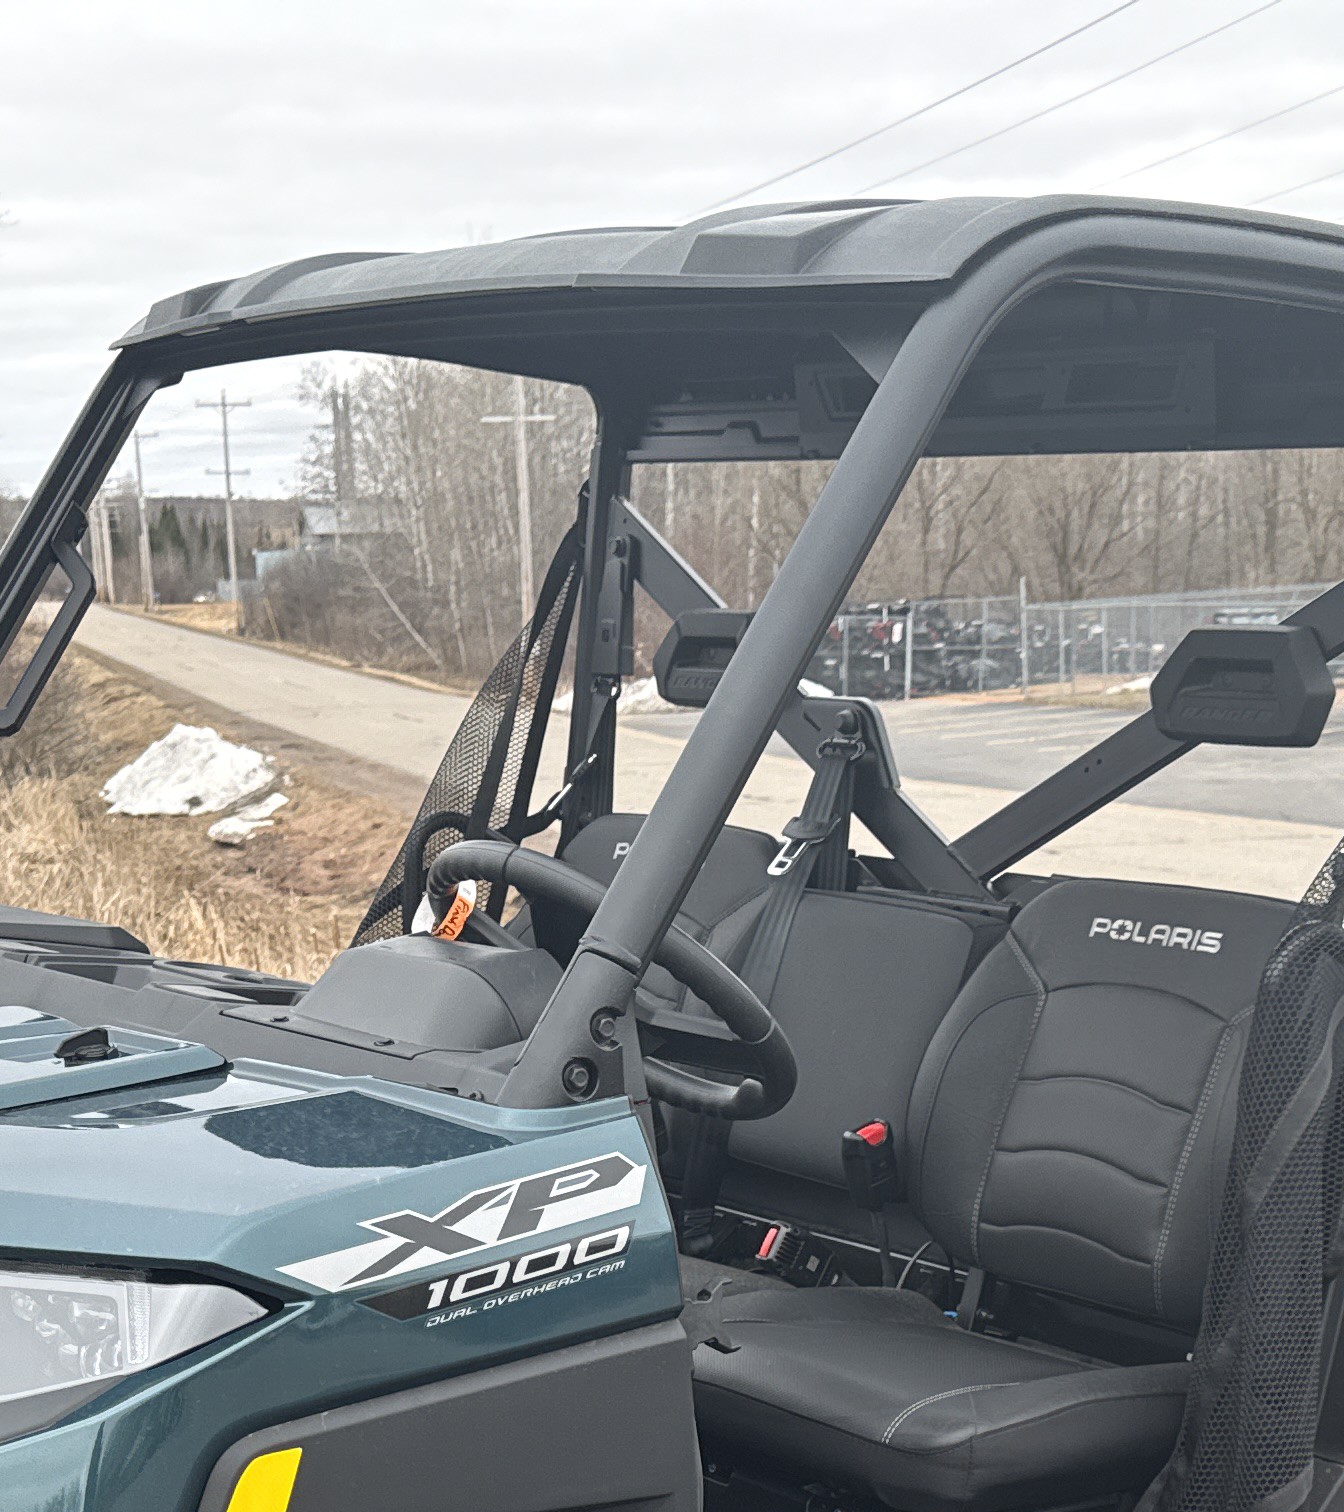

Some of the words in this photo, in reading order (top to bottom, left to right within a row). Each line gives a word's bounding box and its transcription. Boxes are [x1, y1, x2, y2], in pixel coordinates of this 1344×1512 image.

[1088, 917, 1224, 954] POLARIS
[338, 1151, 641, 1291] XP
[426, 1225, 631, 1310] 1000
[426, 1306, 478, 1328] DUAL
[482, 1272, 582, 1311] OVERHEAD
[585, 1259, 626, 1279] CAM
